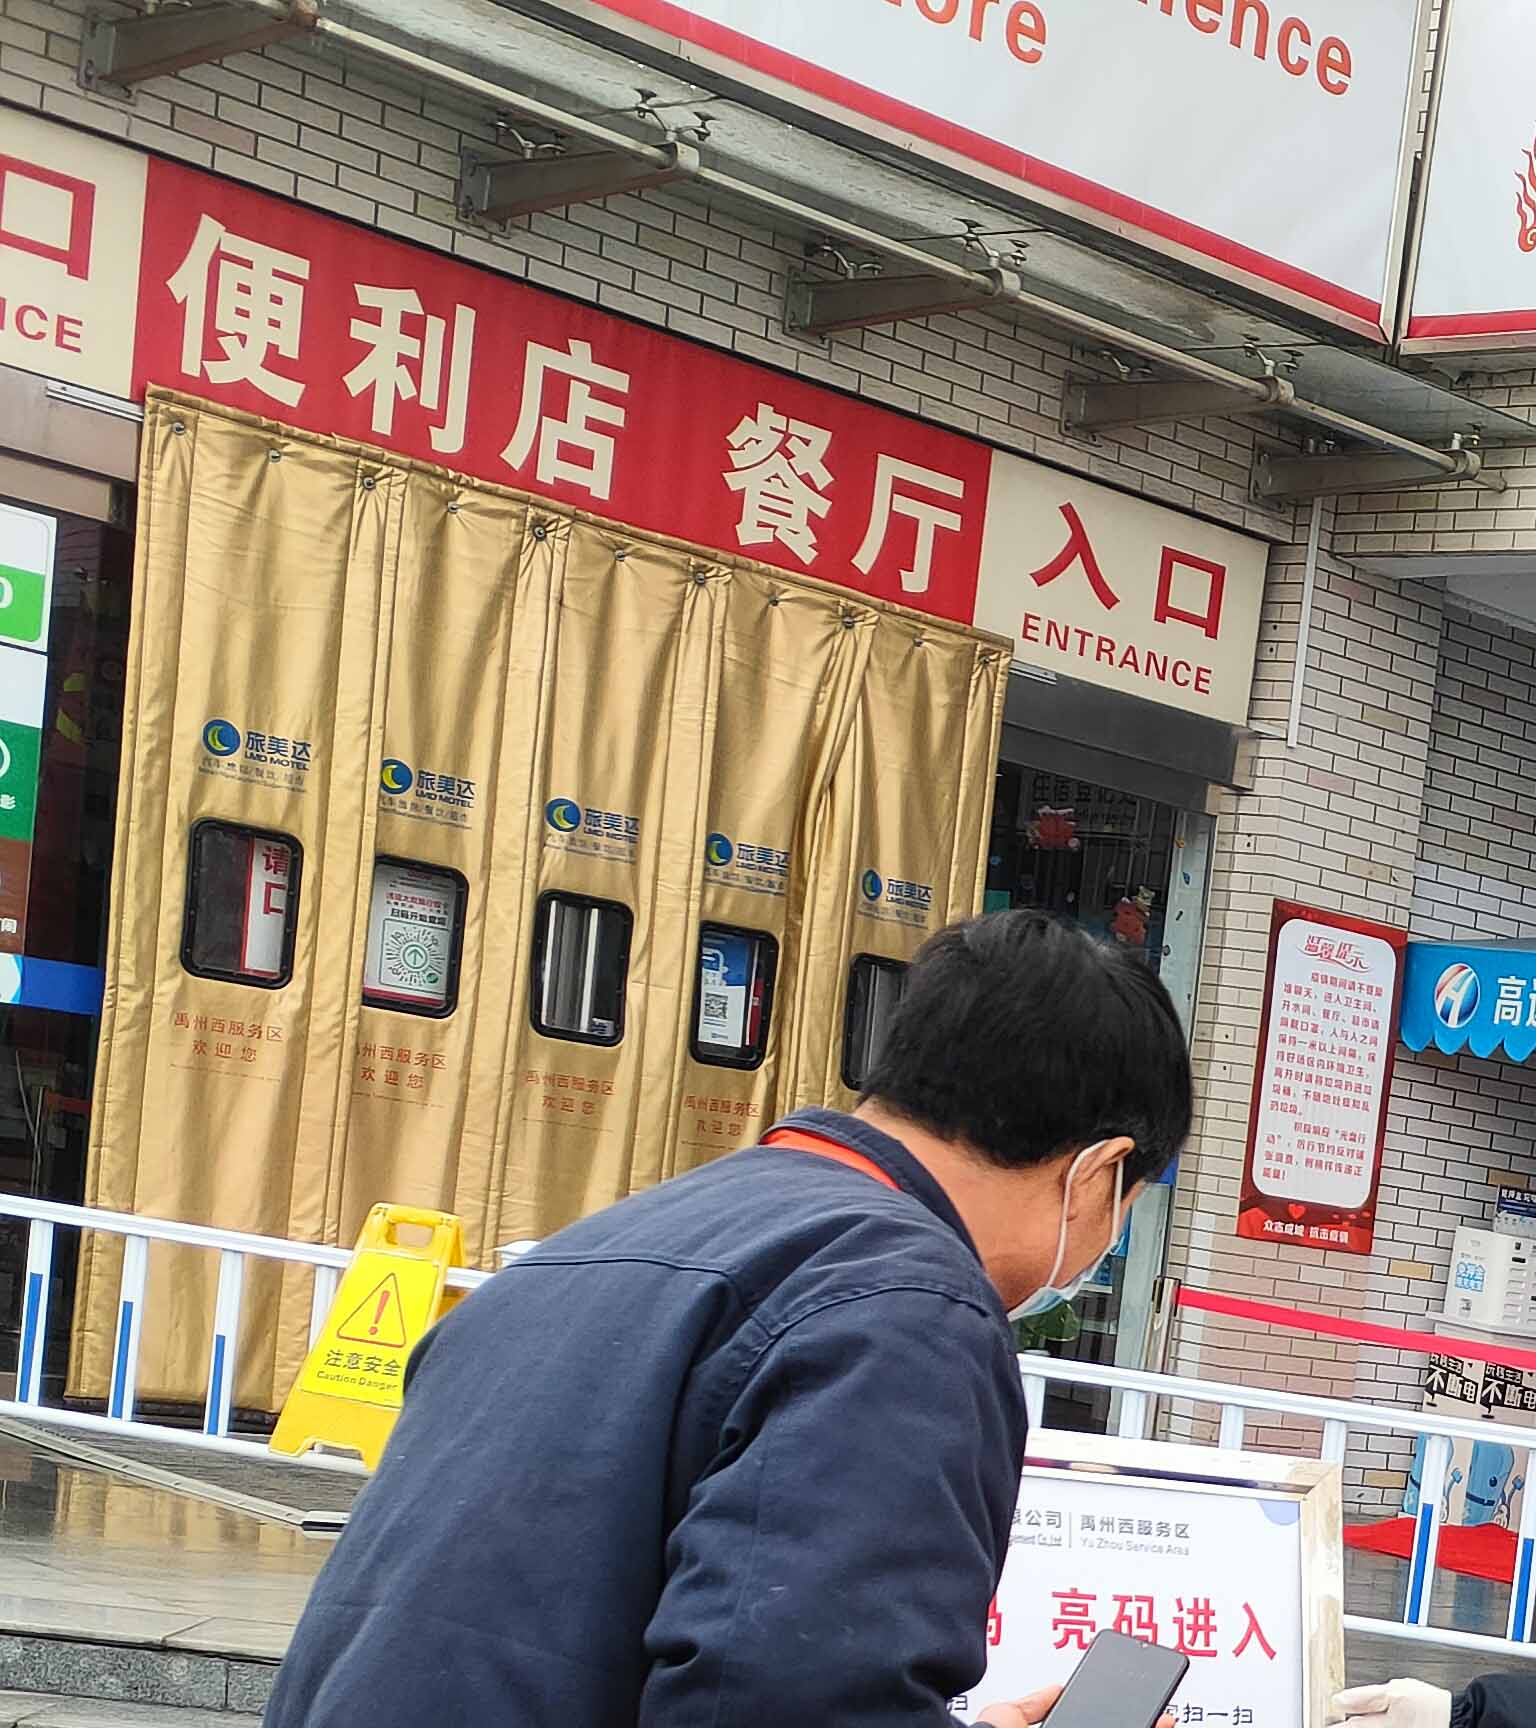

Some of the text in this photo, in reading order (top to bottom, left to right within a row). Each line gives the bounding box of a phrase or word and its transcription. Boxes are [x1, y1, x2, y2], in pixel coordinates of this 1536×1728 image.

[166, 213, 968, 595] 便利店 餐厅
[1031, 502, 1228, 641] 入口
[1020, 612, 1214, 697] ENTRANCE
[245, 729, 312, 762] 旅美达
[416, 769, 476, 800] 旅美达
[1304, 934, 1369, 970] 温馨提示
[174, 1011, 284, 1042] 禹州西服务区
[192, 1039, 258, 1063] 欢迎您
[356, 1041, 449, 1071] 州西服务区
[360, 1066, 425, 1089] 欢迎您
[525, 1070, 616, 1096] 禹州西服务区
[324, 1349, 402, 1378] 注意安全
[316, 1370, 398, 1391] Caution Danger
[1424, 1364, 1477, 1402] 不断电
[1080, 1513, 1190, 1539] 禹州西服务区
[1051, 1587, 1277, 1661] 亮码进入
